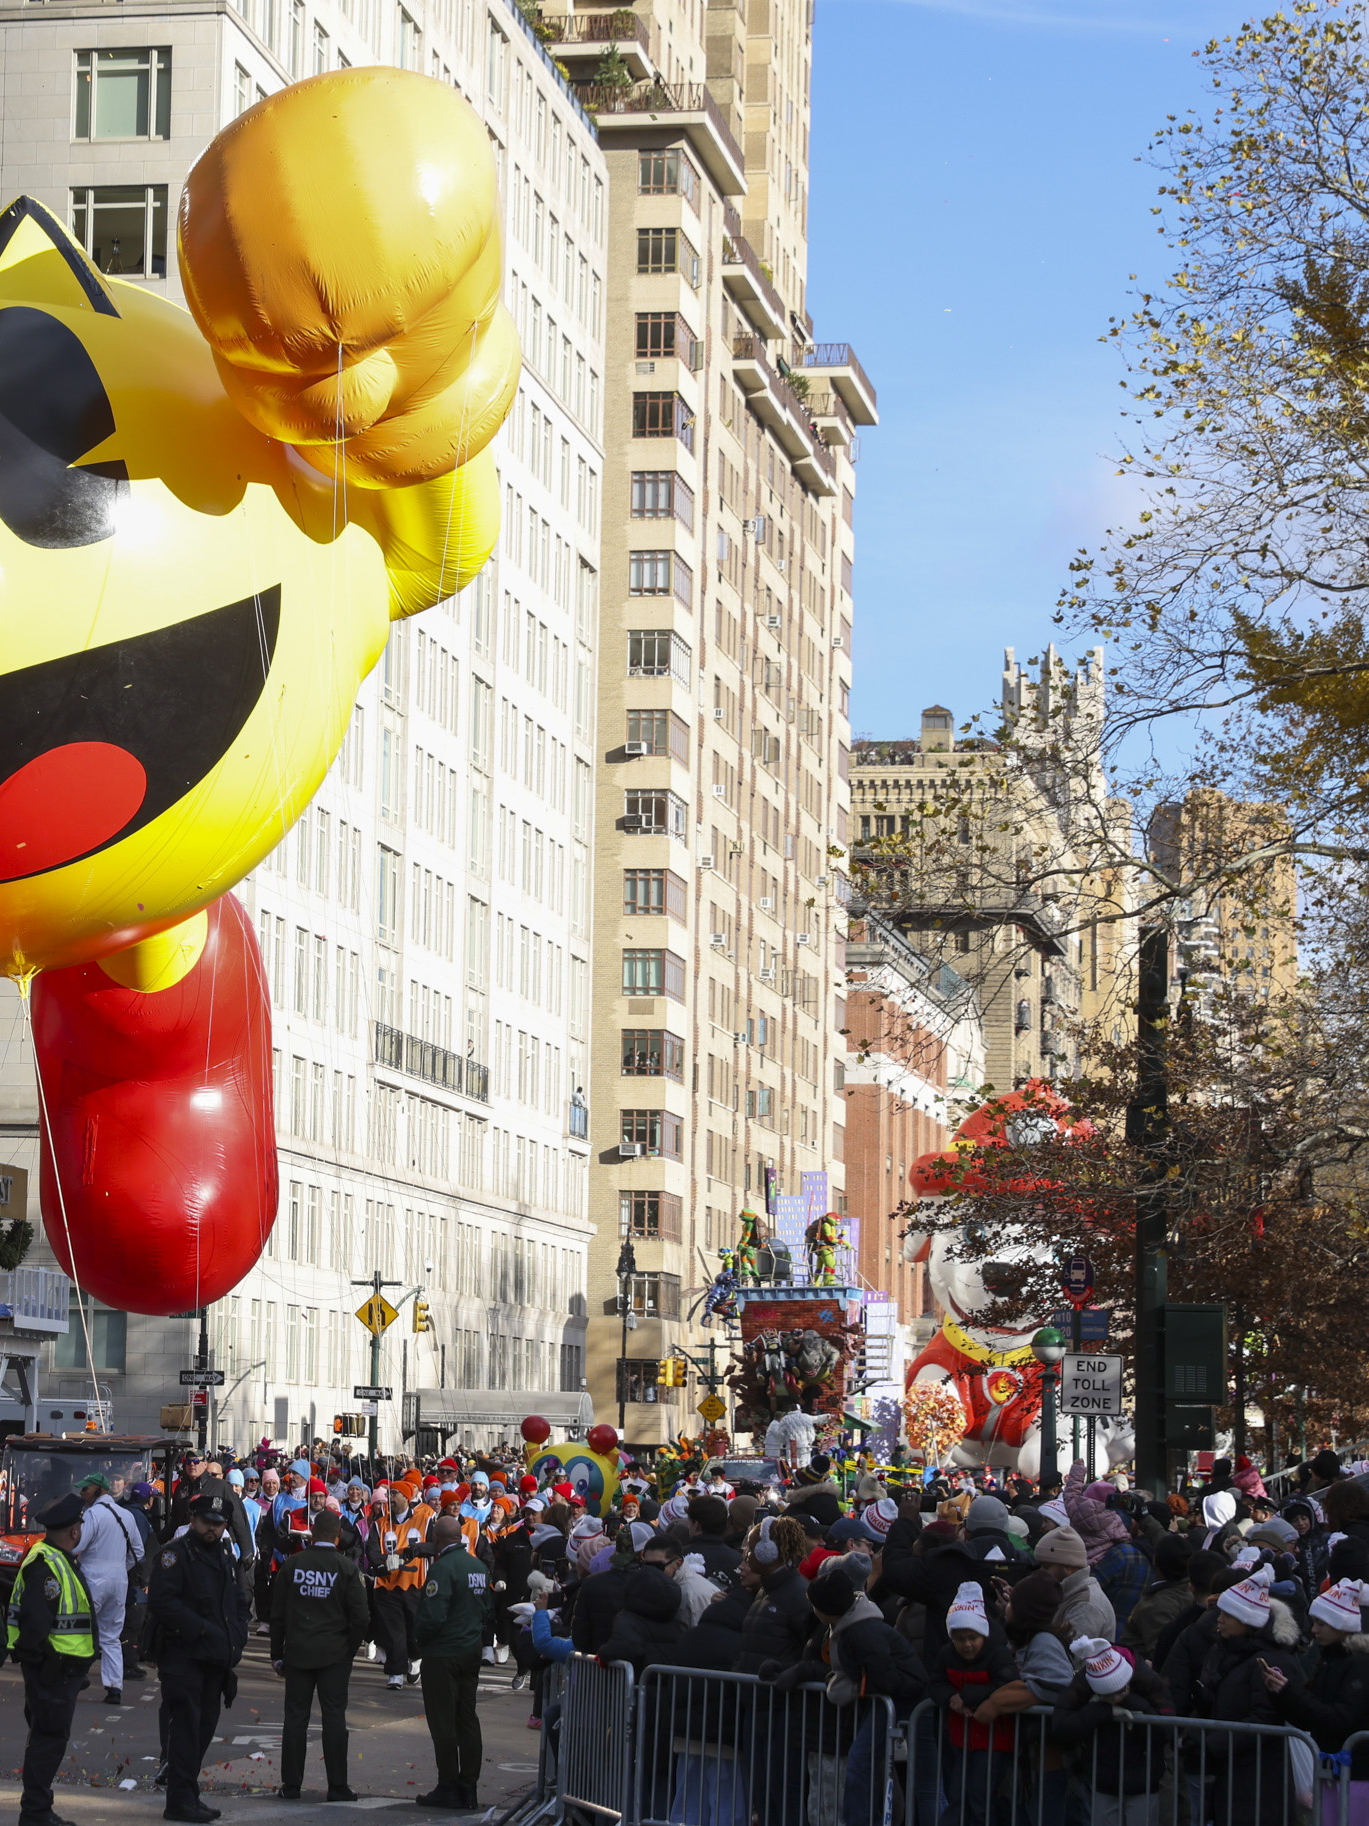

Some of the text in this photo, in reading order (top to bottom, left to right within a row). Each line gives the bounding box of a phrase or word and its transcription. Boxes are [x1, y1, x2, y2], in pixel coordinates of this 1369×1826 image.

[1055, 1312, 1071, 1323] M10
[1057, 1326, 1071, 1337] 20
[1077, 1360, 1107, 1372] END
[1072, 1378, 1111, 1391] TOLL
[1071, 1396, 1111, 1409] ZONE
[293, 1568, 339, 1587] DSNY
[299, 1584, 331, 1598] CHIEF
